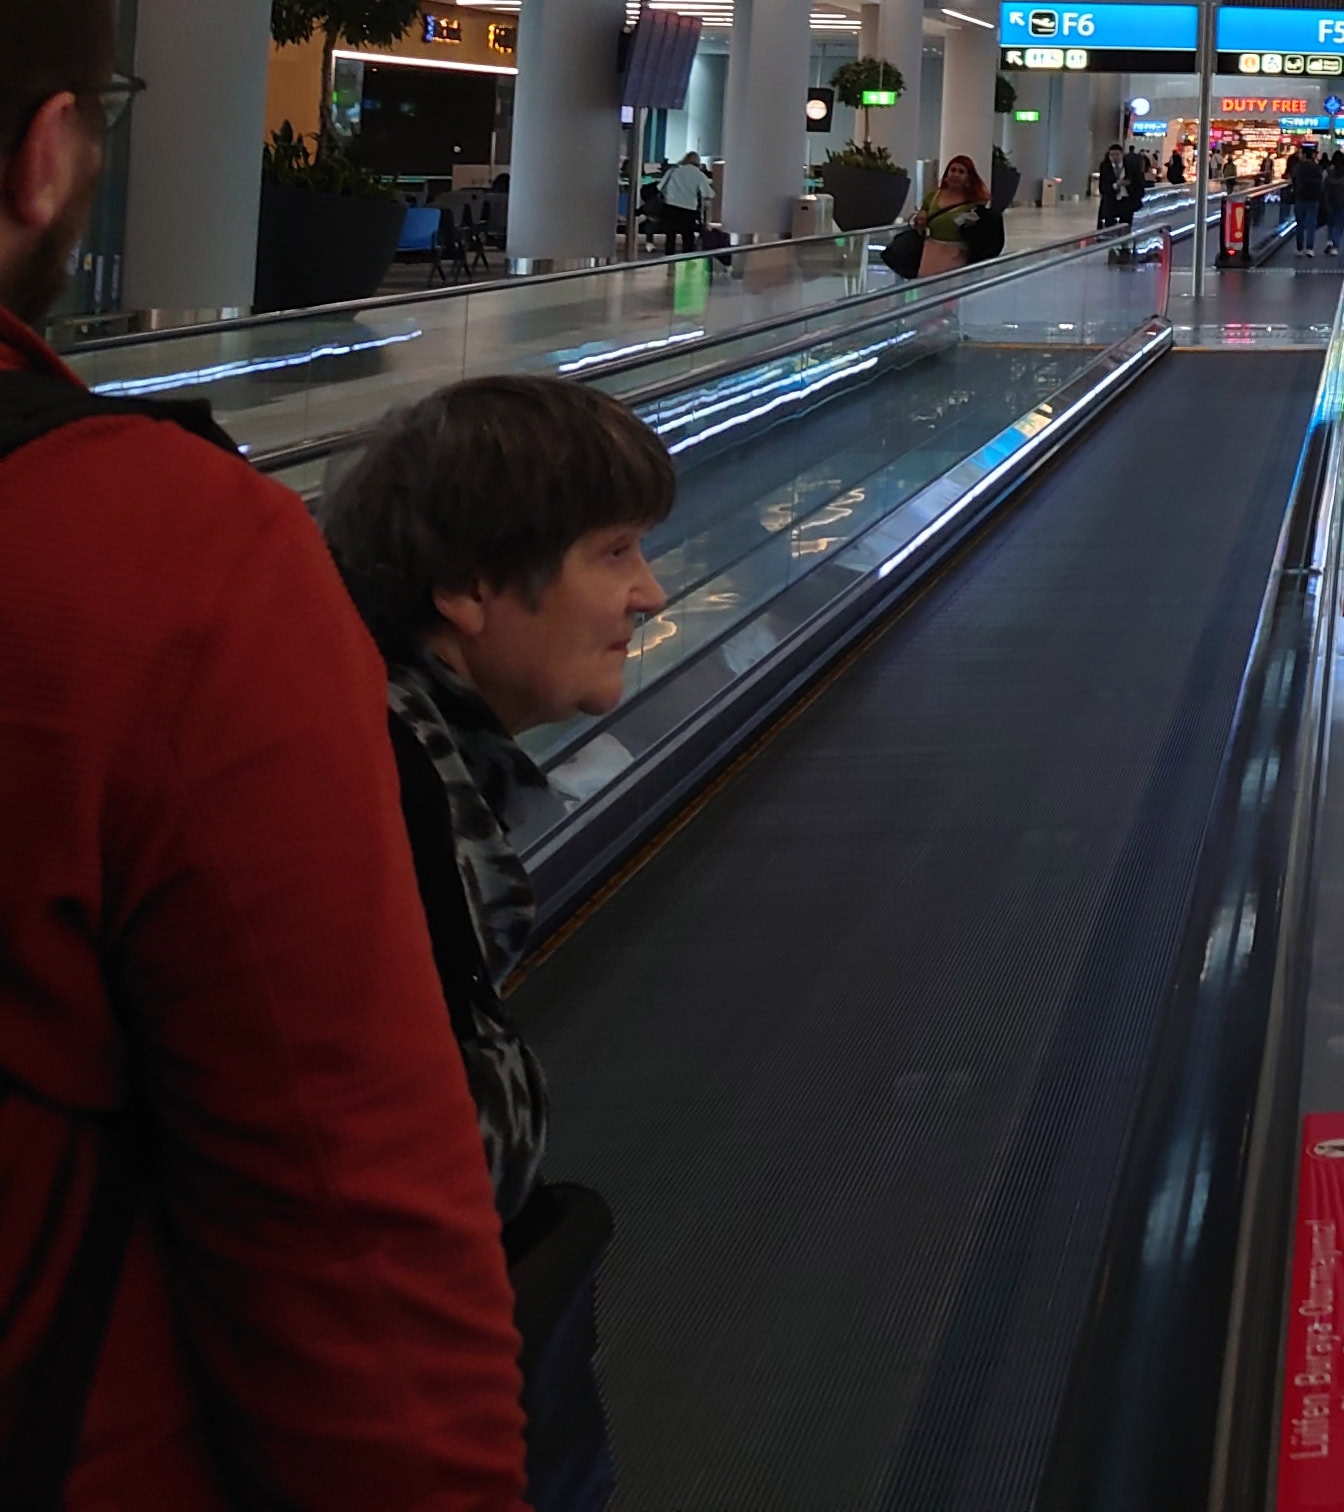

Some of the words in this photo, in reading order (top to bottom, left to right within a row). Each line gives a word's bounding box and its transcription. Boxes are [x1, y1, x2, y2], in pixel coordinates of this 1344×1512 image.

[1062, 12, 1095, 36] F6
[1222, 99, 1267, 112] DUTY
[1272, 99, 1307, 113] FREE
